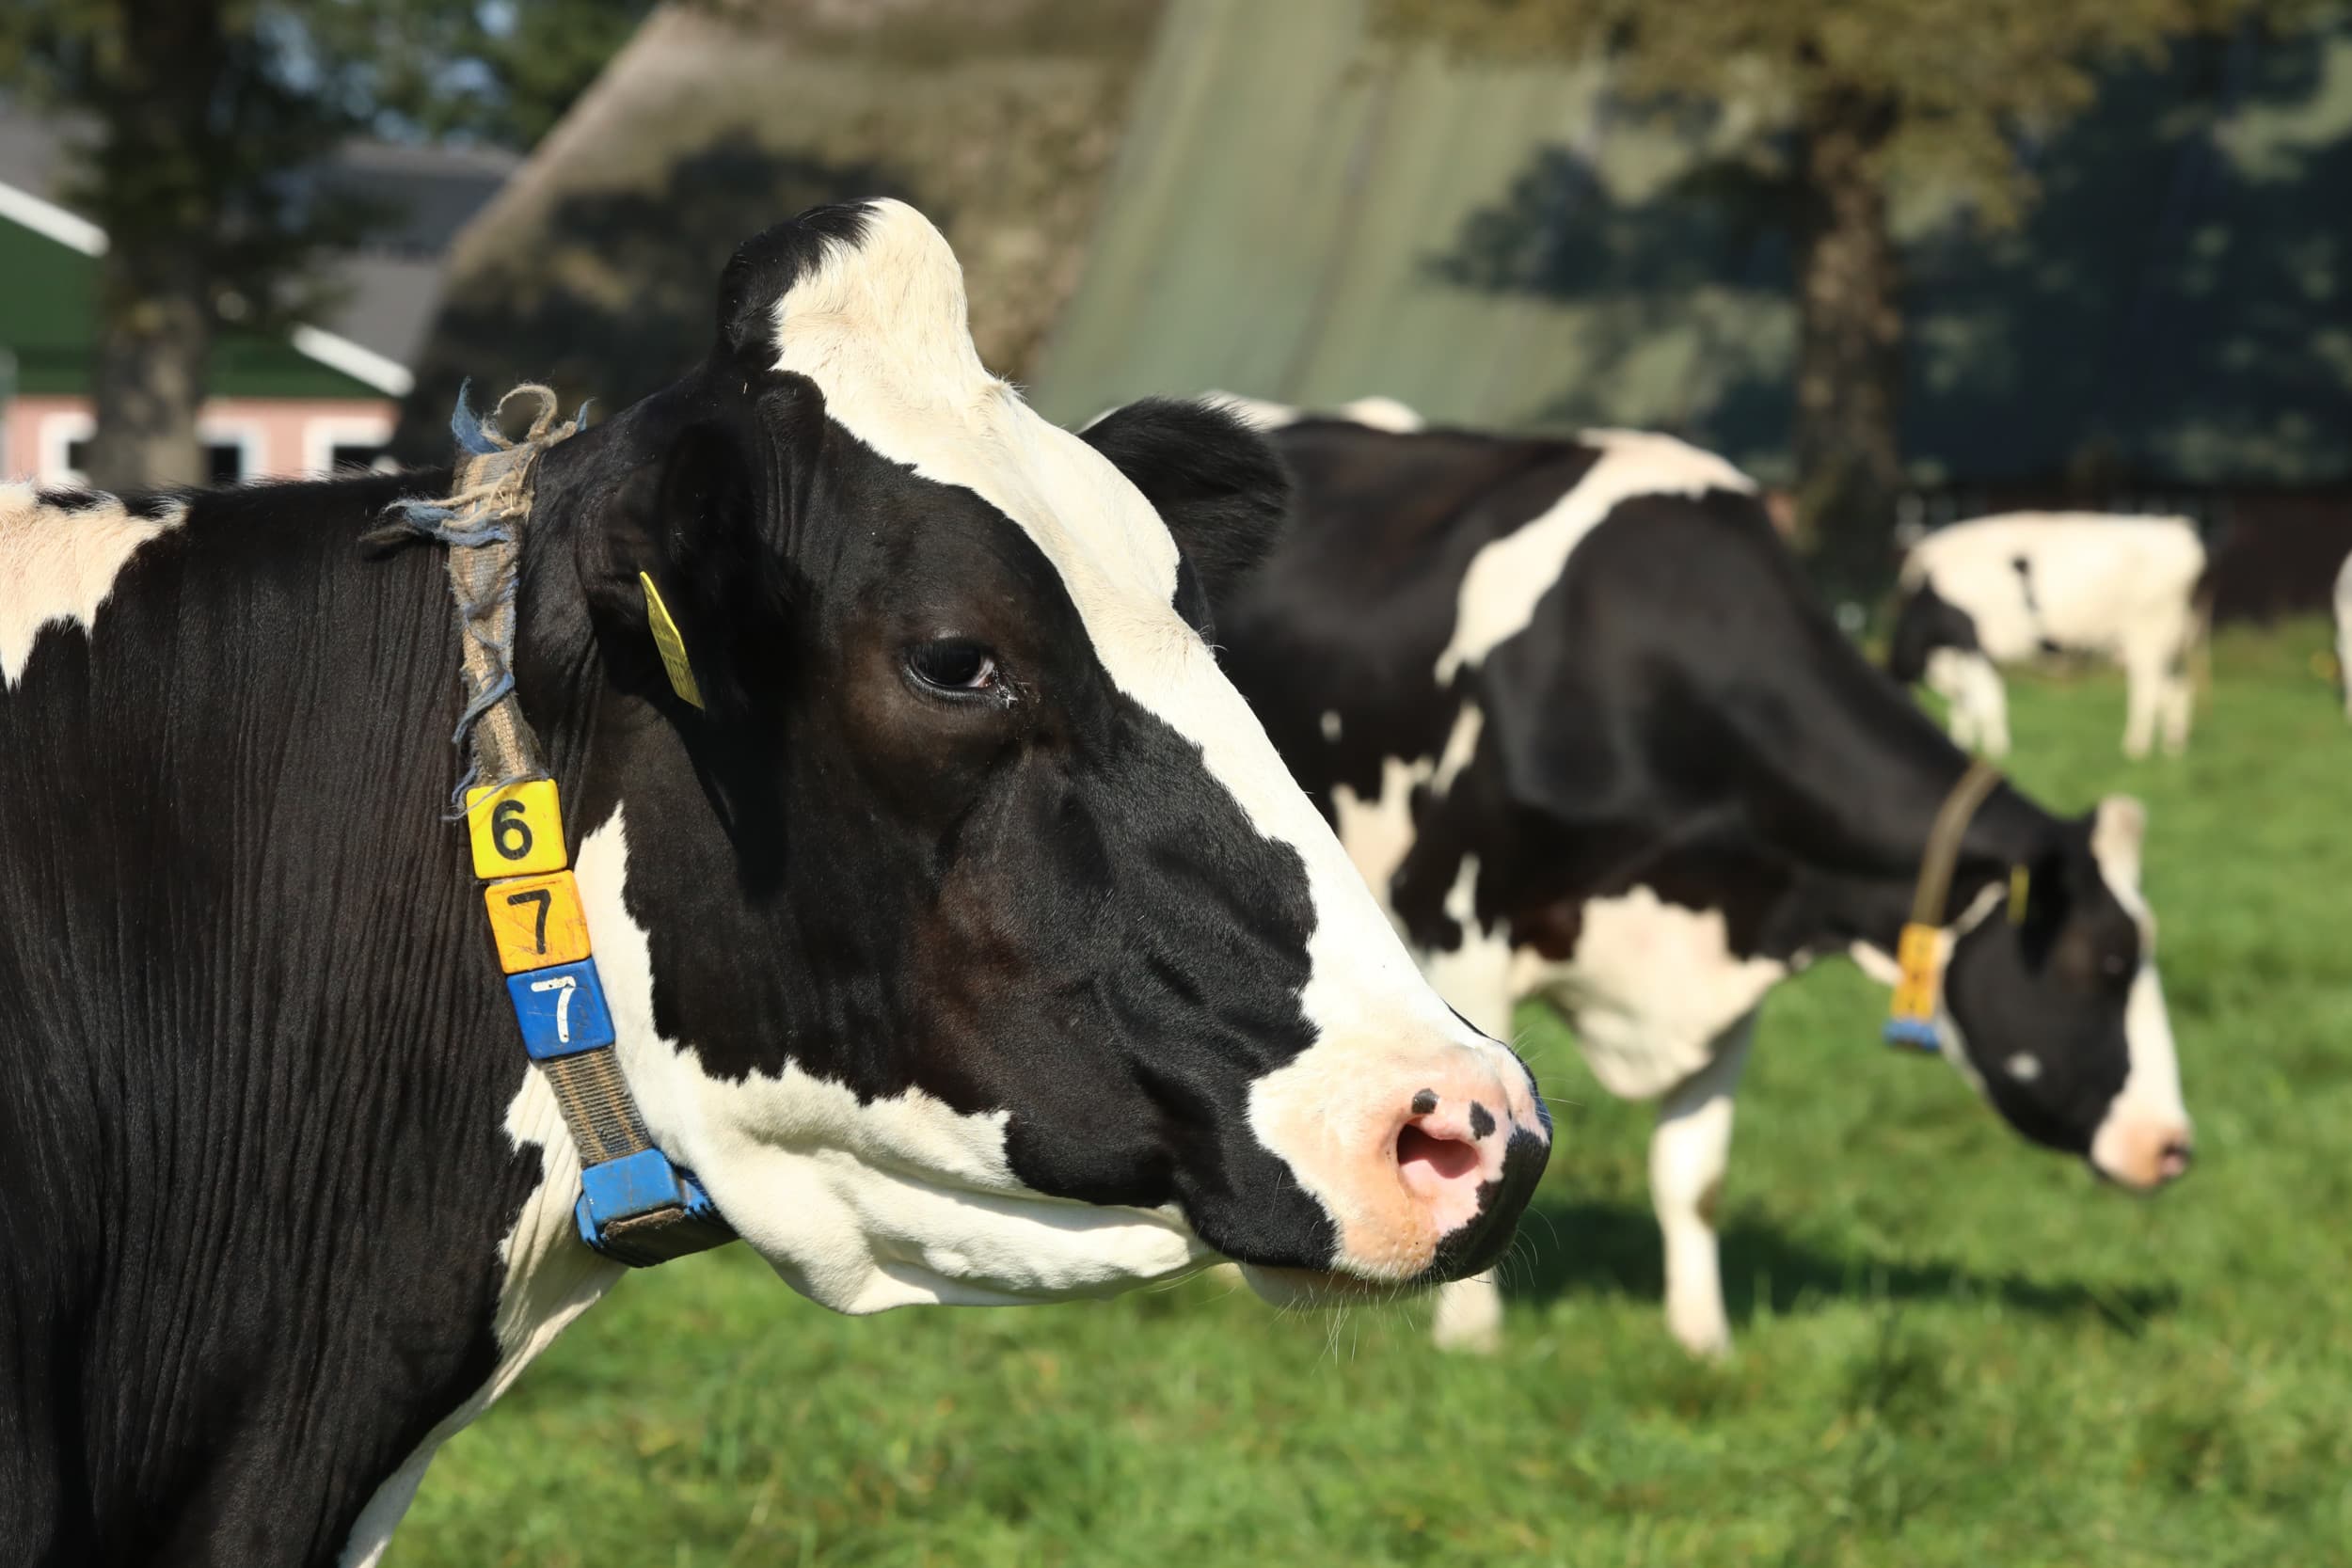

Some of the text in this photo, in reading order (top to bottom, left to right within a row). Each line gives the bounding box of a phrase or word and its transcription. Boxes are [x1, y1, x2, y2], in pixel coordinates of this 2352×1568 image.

[491, 799, 532, 861] 6
[507, 888, 551, 955] 7
[531, 975, 576, 1043] 7
